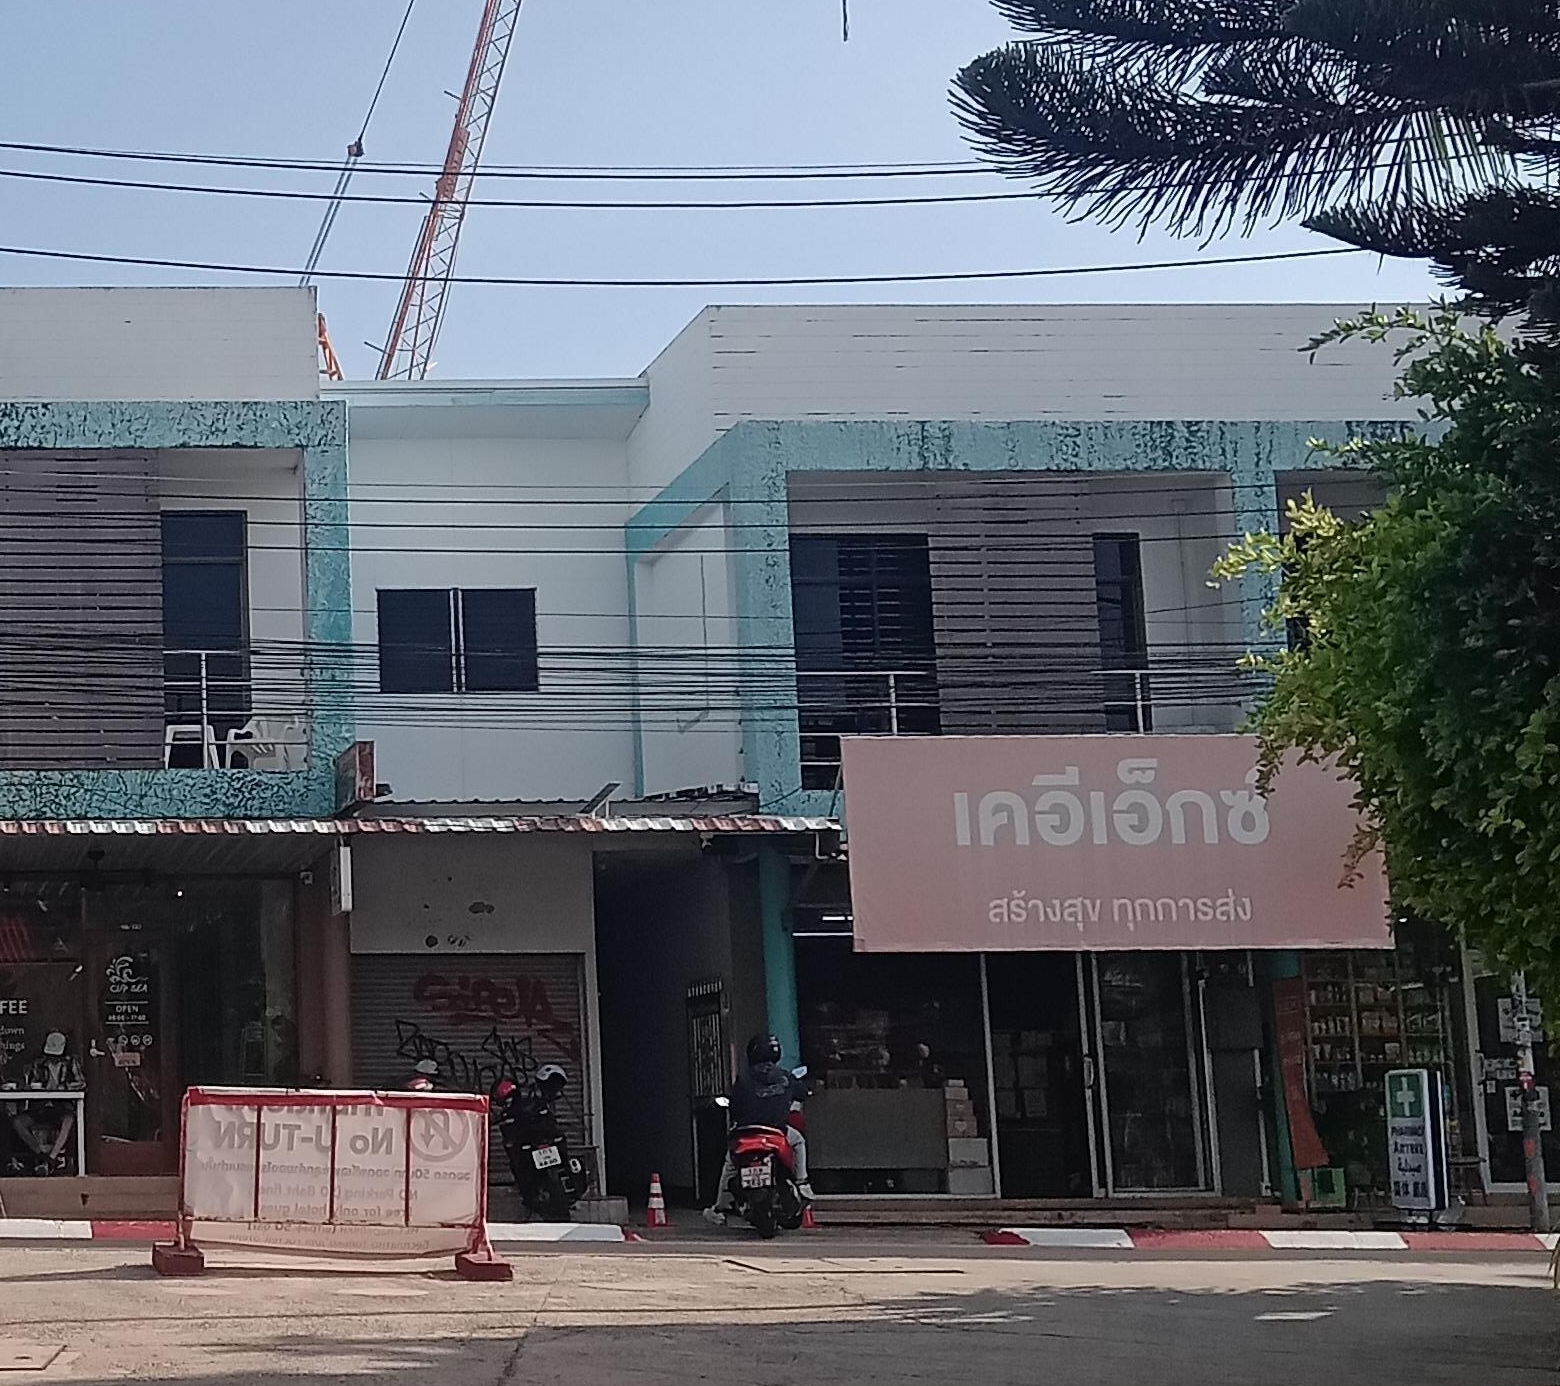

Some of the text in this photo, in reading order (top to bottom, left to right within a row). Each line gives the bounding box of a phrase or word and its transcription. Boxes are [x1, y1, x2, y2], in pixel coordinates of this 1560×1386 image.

[988, 888, 1253, 932] สร้างสุข ทุกการส่ง
[115, 1005, 139, 1013] OPEN
